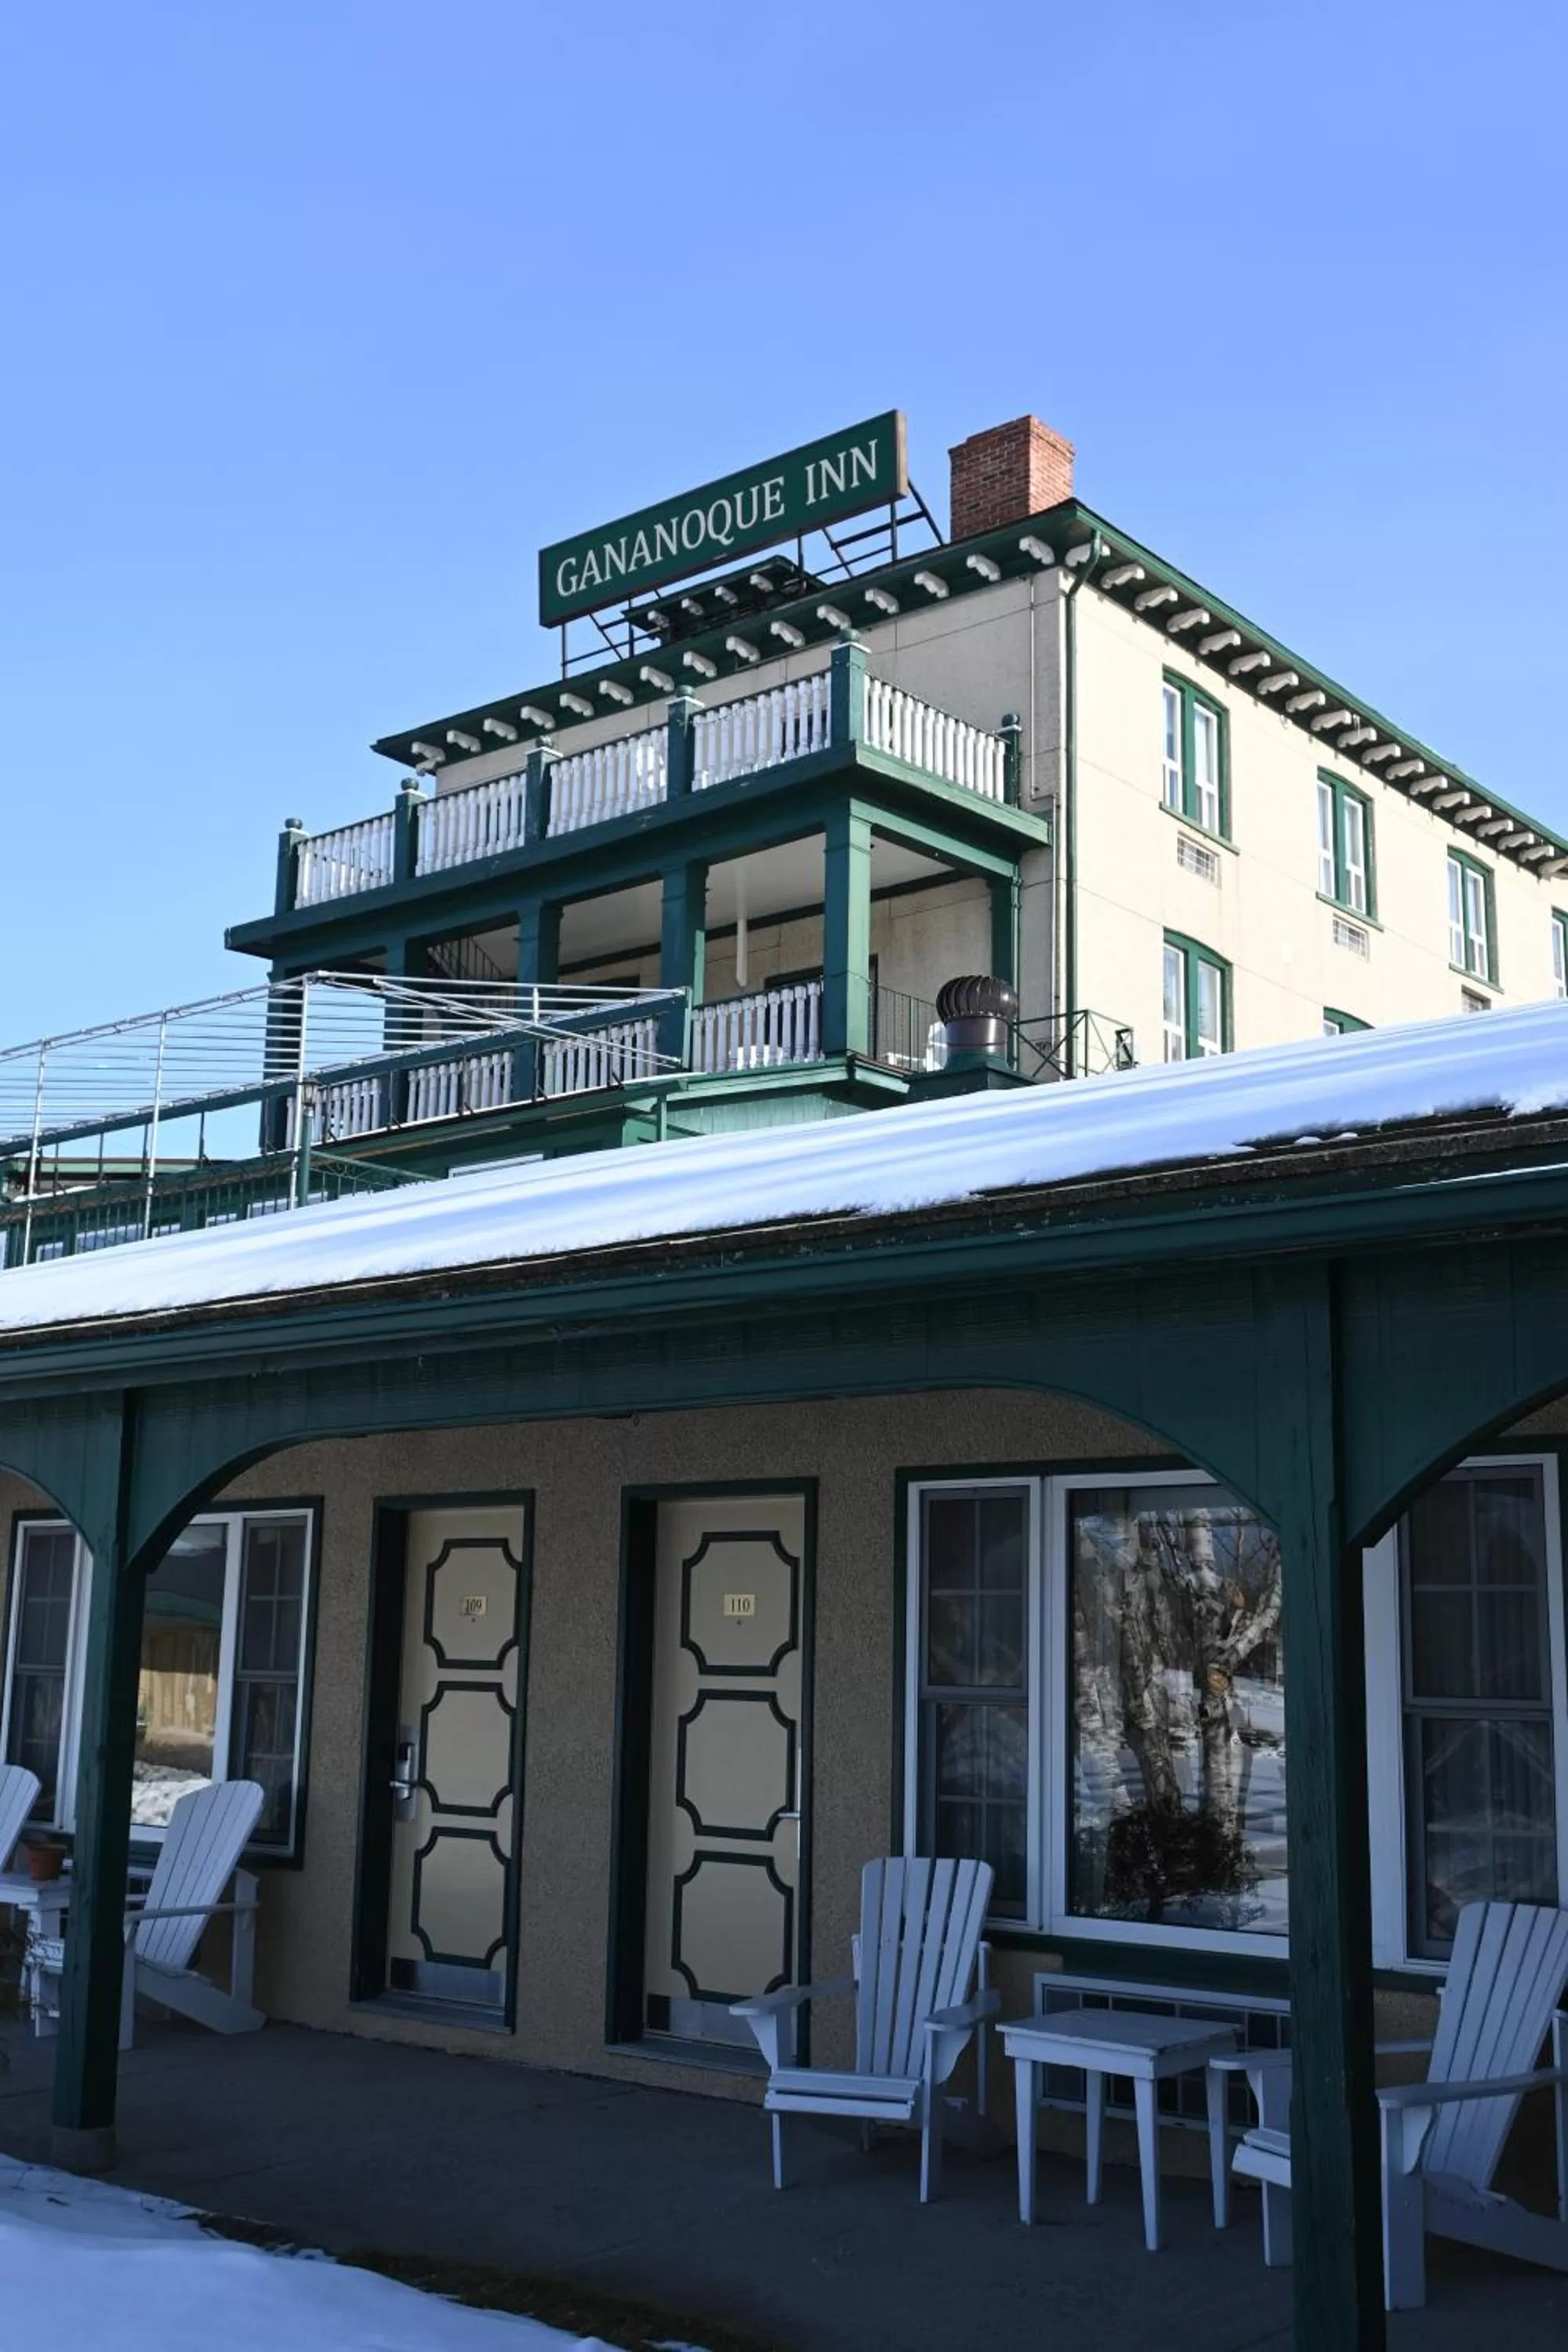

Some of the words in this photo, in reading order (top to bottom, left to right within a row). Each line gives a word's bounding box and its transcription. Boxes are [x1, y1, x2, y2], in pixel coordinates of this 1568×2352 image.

[557, 476, 785, 597] GANANOQUE
[805, 439, 878, 505] INN
[465, 1598, 482, 1613] 109
[731, 1598, 750, 1613] 110
